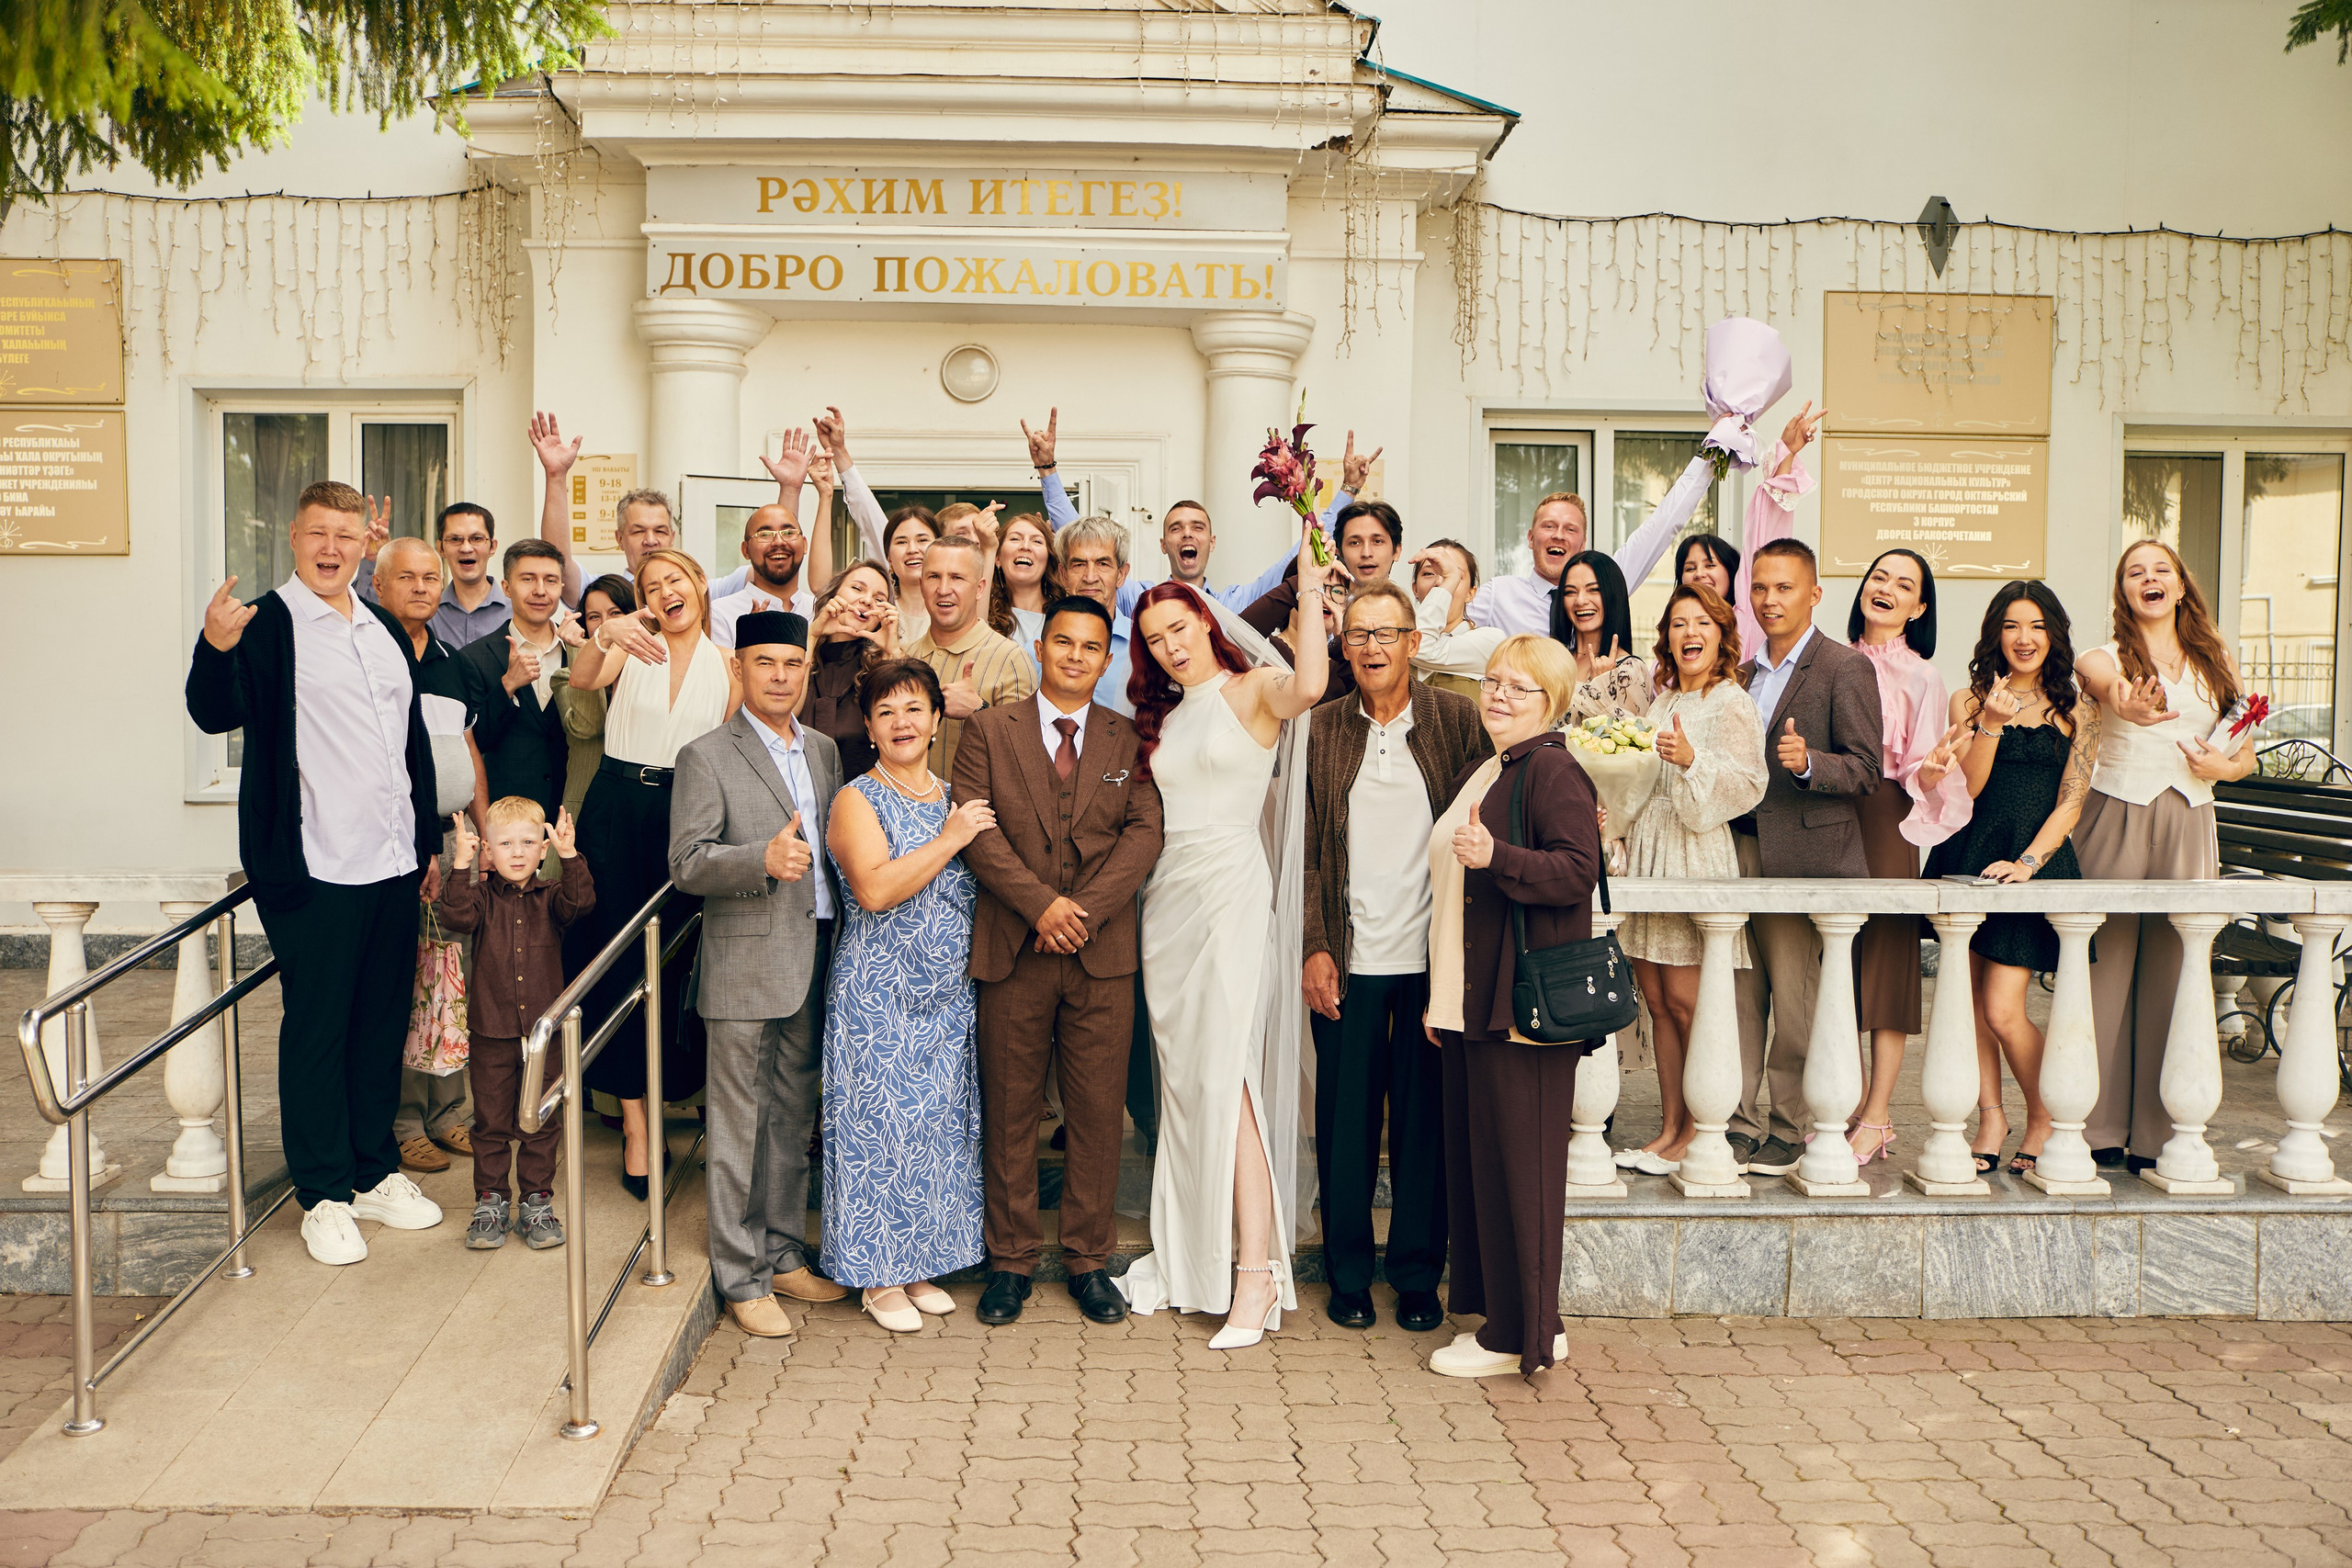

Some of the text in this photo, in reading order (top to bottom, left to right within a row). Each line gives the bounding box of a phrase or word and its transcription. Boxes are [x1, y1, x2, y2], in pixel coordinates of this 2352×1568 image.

[756, 175, 948, 215] РӘХИМ
[659, 253, 1274, 301] ДОБРО ПОЖАЛОВАТЬ!
[0, 297, 95, 309] ЕСПУБЛИҠАҺЫНЫҢ
[19, 310, 66, 321] БУЙЫНСА
[1839, 460, 2031, 475] МУНИЦИПАЛЬНОЕ БЮДЖЕТНОЕ УЧРЕЖДЕНИЕ
[599, 479, 622, 488] 9-18
[1894, 475, 1967, 487] НАЦИОНАЛЬНЫХ
[3, 491, 28, 502] БИНА
[1841, 488, 2028, 502] ГОРОДСКОГО ОКРУГА ГОРОД ОКТЯБРЬСКИЙ
[599, 509, 615, 518] 9-1
[1870, 502, 1998, 514] РЕСПУБЛИКИ БАШКОРТОСТАН
[1921, 516, 1955, 527] КОРПУС
[1876, 529, 1992, 541] ДВОРЕЦ БРАКОСОЧЕТАНИЯ
